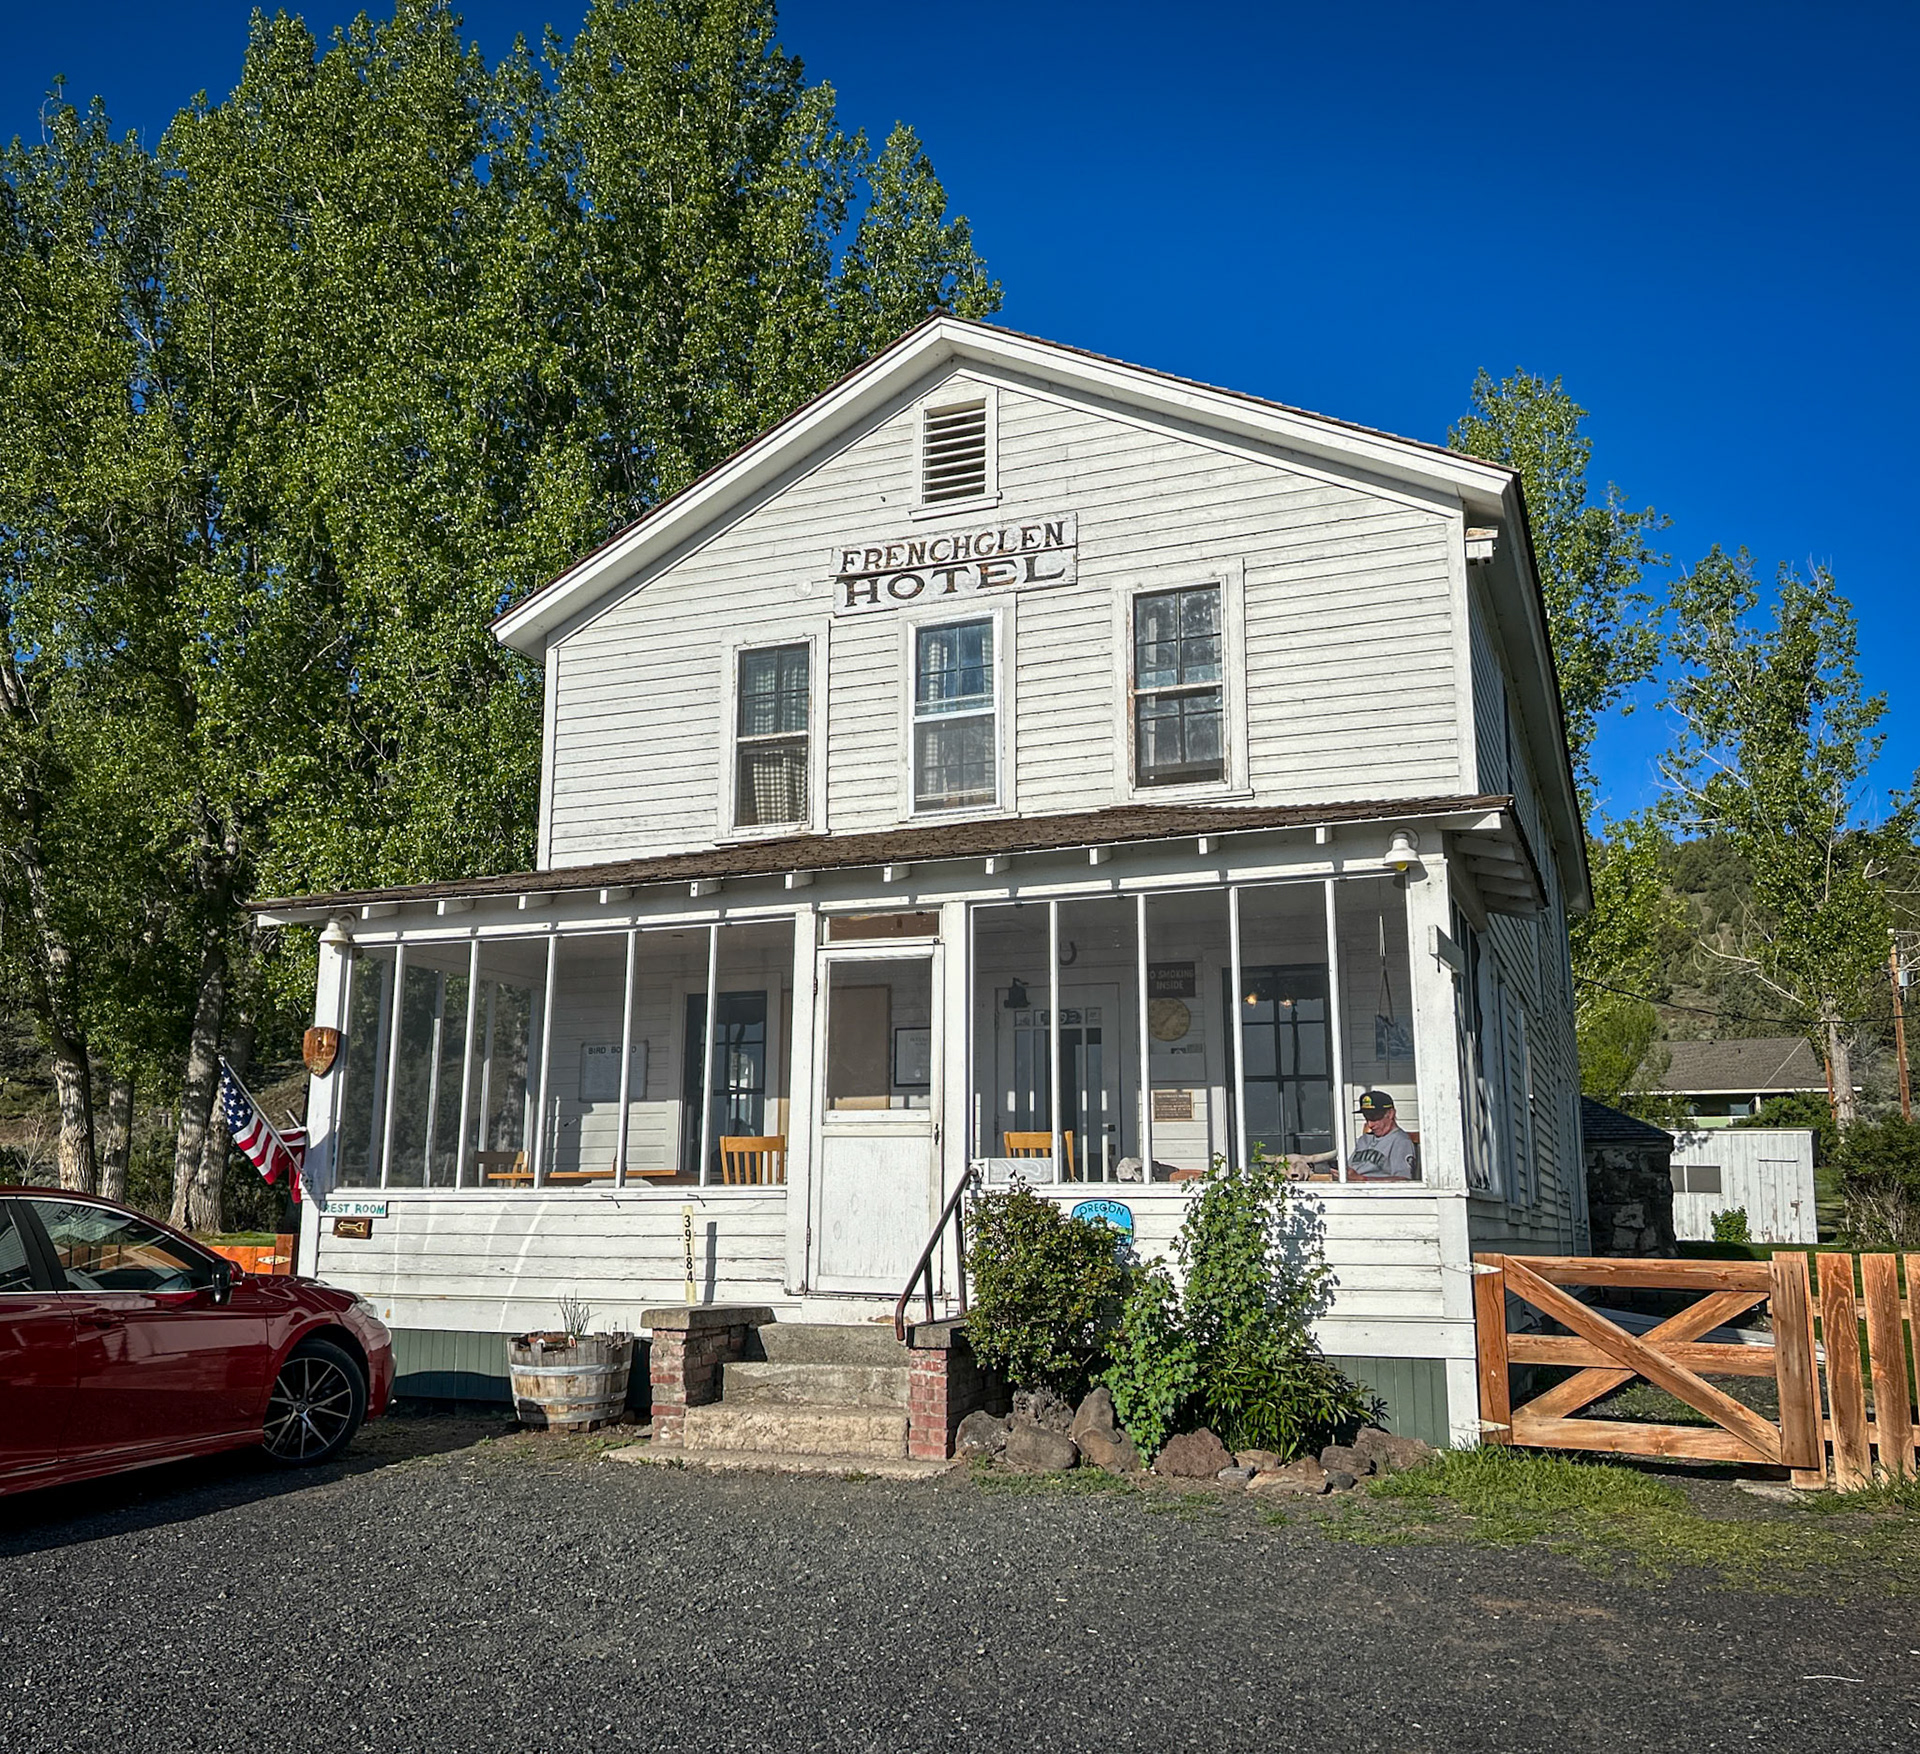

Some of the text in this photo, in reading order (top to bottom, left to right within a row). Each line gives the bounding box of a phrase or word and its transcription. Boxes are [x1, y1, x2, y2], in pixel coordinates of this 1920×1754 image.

[840, 520, 1066, 574] FRENCHGLEN
[843, 554, 1066, 608] HOTEL
[1157, 969, 1194, 980] SMOKING
[1156, 980, 1185, 990] INSIDE
[588, 1045, 637, 1055] BIRD BOD
[324, 1203, 385, 1214] REST ROOM
[1079, 1202, 1125, 1216] OREGON
[684, 1214, 694, 1284] 39184
